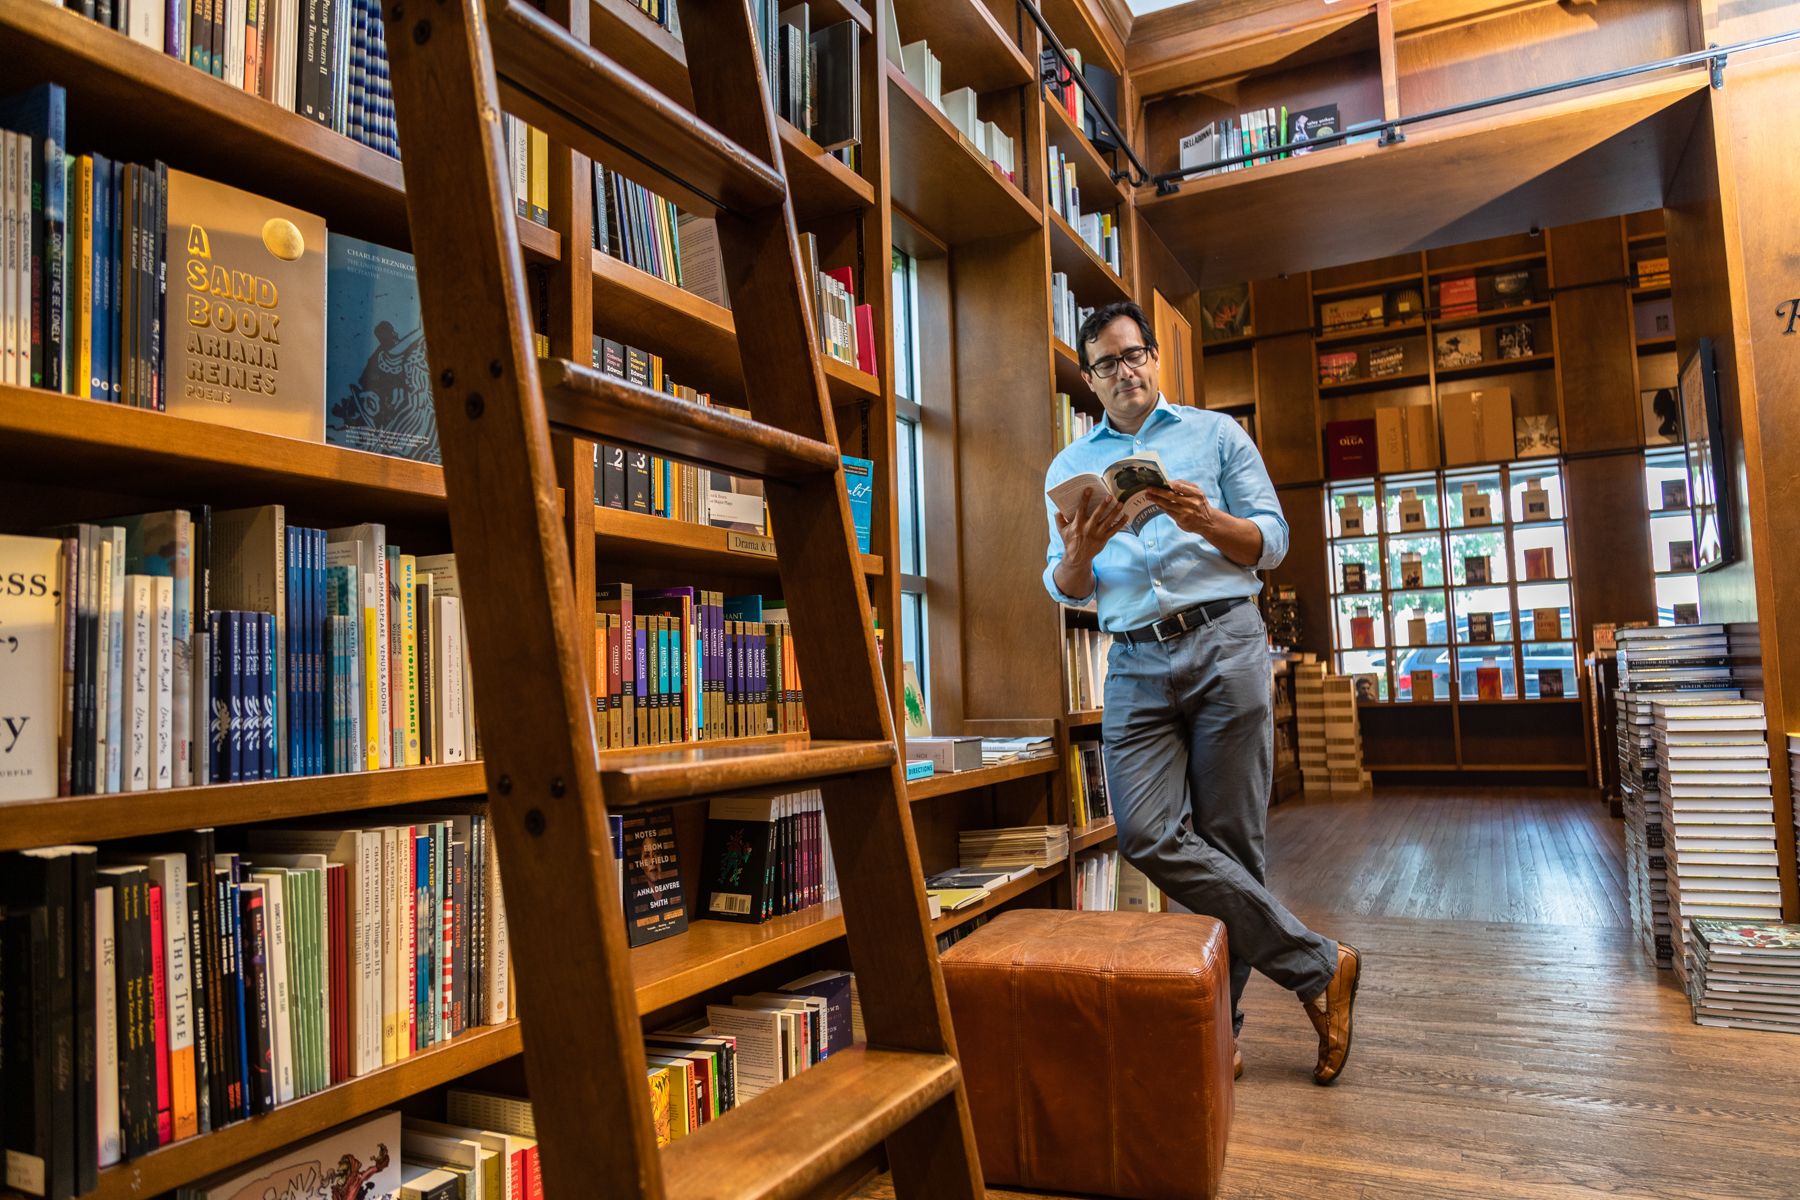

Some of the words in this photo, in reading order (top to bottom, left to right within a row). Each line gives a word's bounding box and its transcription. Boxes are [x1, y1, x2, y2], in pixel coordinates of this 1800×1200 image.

[308, 25, 317, 62] THOUGHTS
[320, 28, 329, 64] THOUGHTS
[320, 65, 328, 75] II
[1183, 128, 1212, 150] BELLADONNA
[33, 182, 41, 211] PLOT
[599, 204, 608, 240] Ginsberg
[52, 233, 62, 261] DON'T
[187, 224, 212, 260] A
[347, 248, 380, 262] CHARLES
[381, 258, 418, 272] REZNIKOF
[52, 262, 61, 280] LET
[52, 280, 61, 293] ME
[160, 282, 166, 294] Me
[186, 260, 278, 310] SAND
[52, 295, 61, 306] BE
[52, 309, 61, 343] LONELY
[187, 294, 280, 345] BOOK
[186, 331, 279, 371] ARIANA
[186, 358, 276, 397] REINES
[607, 365, 623, 377] Edward
[630, 369, 647, 380] Edward
[631, 377, 643, 386] Albee
[185, 385, 232, 404] POEMS
[1339, 438, 1364, 447] OLGA
[614, 448, 623, 468] 2
[637, 453, 646, 469] 3
[735, 536, 759, 551] Drama
[760, 543, 767, 552] &
[908, 764, 933, 775] DIRECTIONS
[634, 829, 657, 840] NOTES
[643, 842, 663, 852] FROM
[635, 860, 649, 869] THE
[651, 856, 669, 865] FIELD
[637, 888, 654, 897] ANNA
[655, 881, 680, 893] DEAVERE
[650, 898, 669, 909] SMITH
[193, 910, 200, 920] IN
[497, 913, 506, 948] ALICE
[174, 933, 188, 983] THIS
[365, 952, 372, 961] as
[374, 949, 381, 958] as
[365, 962, 372, 970] It
[365, 971, 372, 980] Is
[374, 968, 381, 976] Is
[497, 950, 506, 994] WALKER
[410, 971, 415, 982] OF
[127, 980, 135, 1000] That
[136, 977, 144, 997] That
[137, 999, 145, 1021] Train
[260, 1002, 266, 1010] OF
[175, 991, 189, 1041] TIME
[128, 1026, 136, 1050] Again
[199, 1039, 207, 1063] STERN
[511, 1161, 519, 1200] BARRE
[533, 1153, 542, 1197] BARREN
